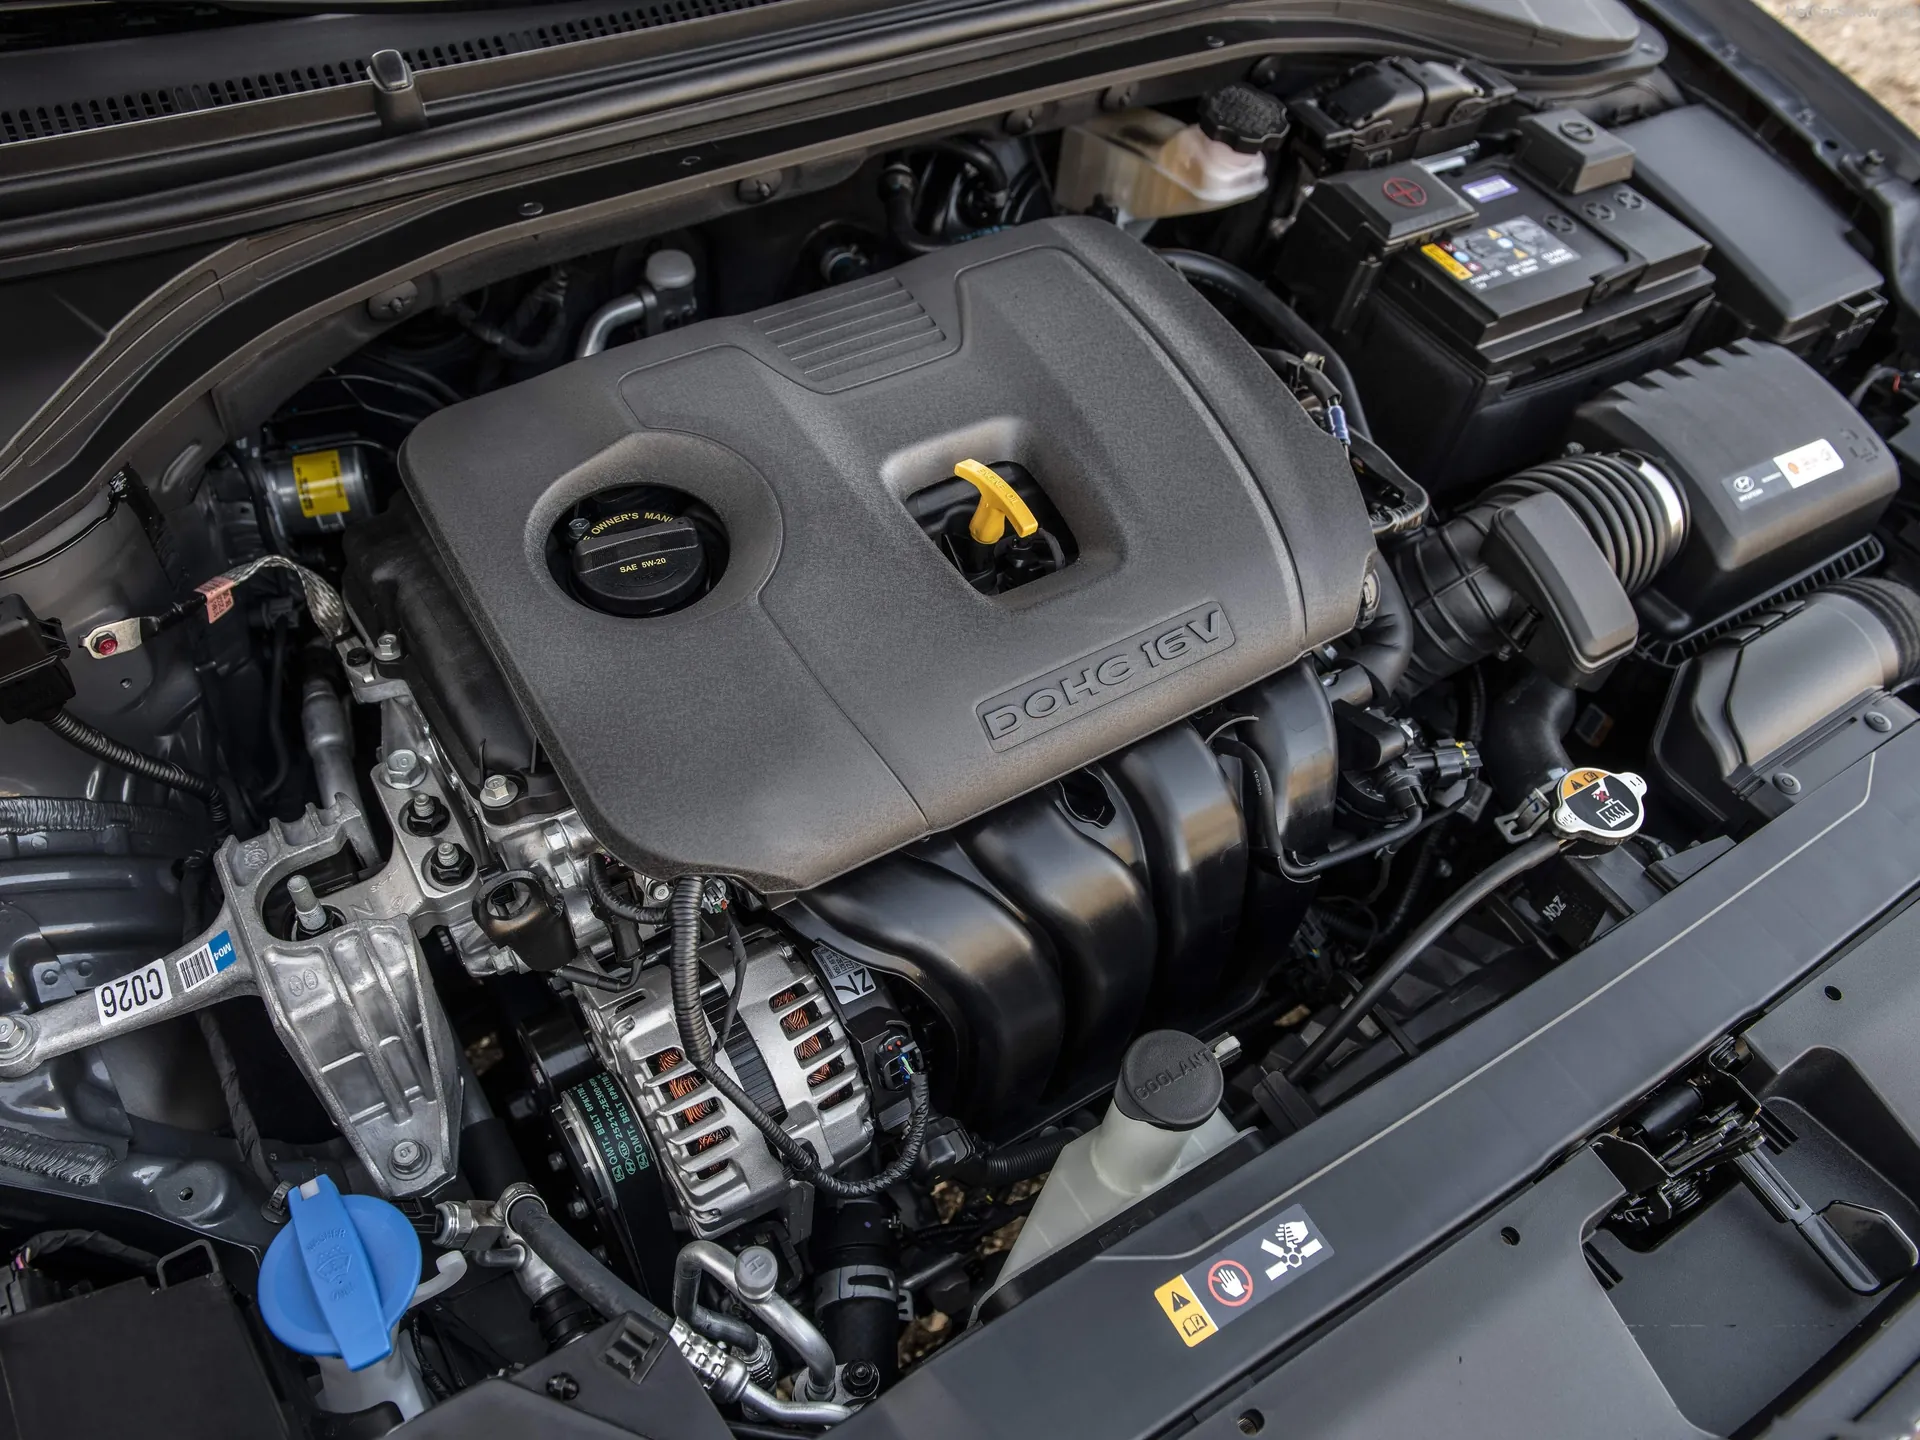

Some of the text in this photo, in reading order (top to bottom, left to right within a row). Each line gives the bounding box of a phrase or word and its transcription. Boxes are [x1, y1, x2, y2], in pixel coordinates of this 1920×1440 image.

[591, 512, 639, 535] OWNER'S
[619, 557, 667, 573] SAE 5W-20
[983, 610, 1222, 740] DOHC 16V
[1542, 895, 1567, 921] NDZ
[214, 943, 232, 961] M04
[101, 968, 164, 1018] C026
[1134, 1049, 1211, 1100] COOLANT
[614, 1102, 631, 1124] BELT
[589, 1114, 606, 1136] BELT
[619, 1142, 630, 1159] KIA
